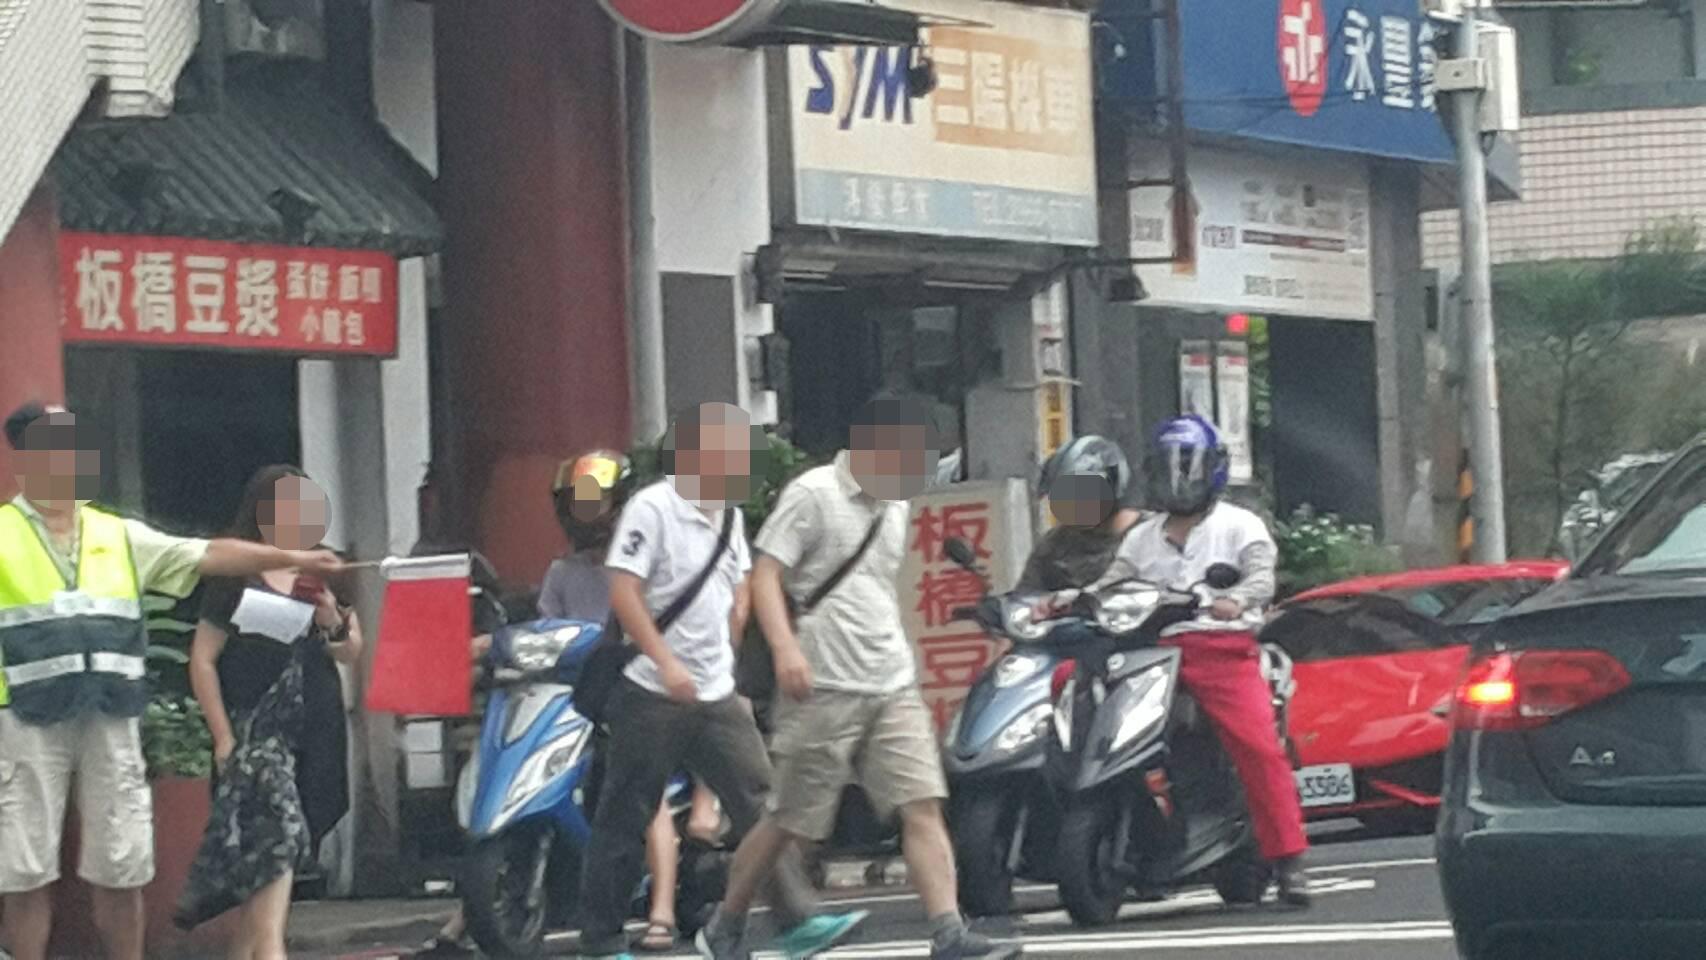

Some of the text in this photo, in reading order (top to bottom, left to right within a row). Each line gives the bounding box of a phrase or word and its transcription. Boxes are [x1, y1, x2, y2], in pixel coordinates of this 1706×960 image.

[805, 45, 914, 130] SYM
[75, 246, 280, 336] 板橋豆漿
[622, 529, 646, 557] 3
[911, 502, 993, 745] 板橋豆
